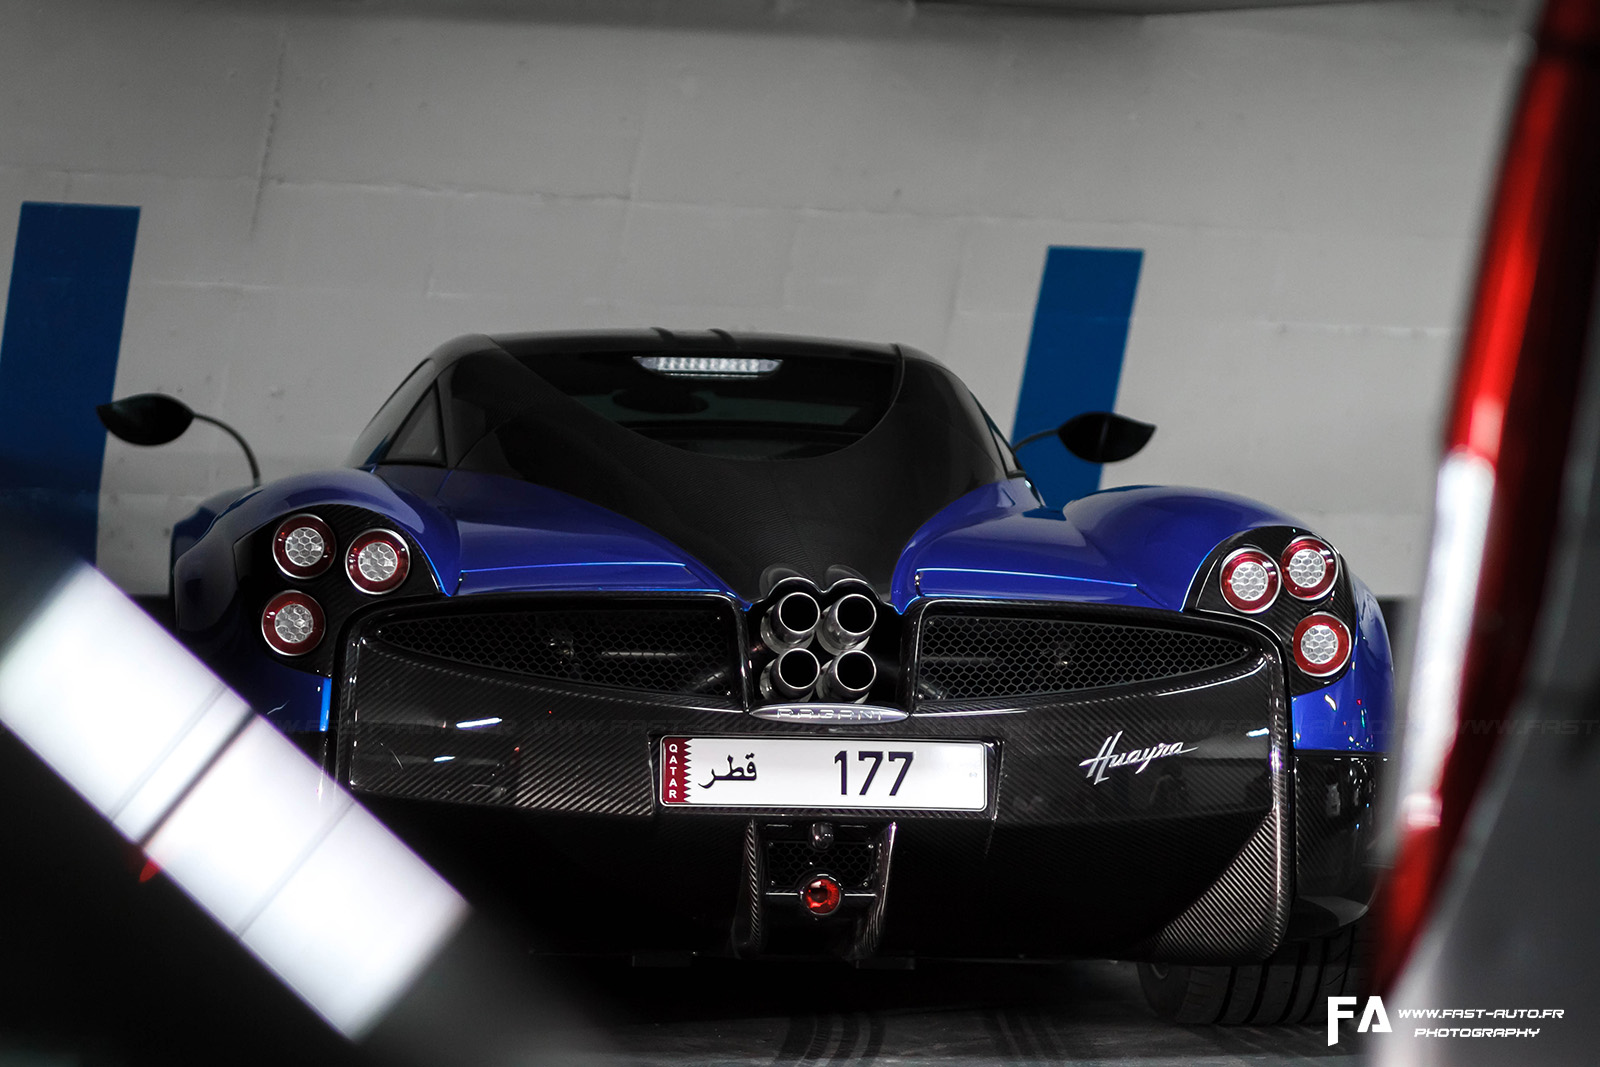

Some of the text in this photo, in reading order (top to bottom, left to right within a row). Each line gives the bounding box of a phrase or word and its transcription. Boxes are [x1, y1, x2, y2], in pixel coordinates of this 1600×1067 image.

[776, 708, 883, 722] PAGANI
[668, 743, 679, 799] QATAR
[698, 752, 757, 790] قطر
[834, 750, 914, 797] 177
[1079, 730, 1199, 786] Huayra
